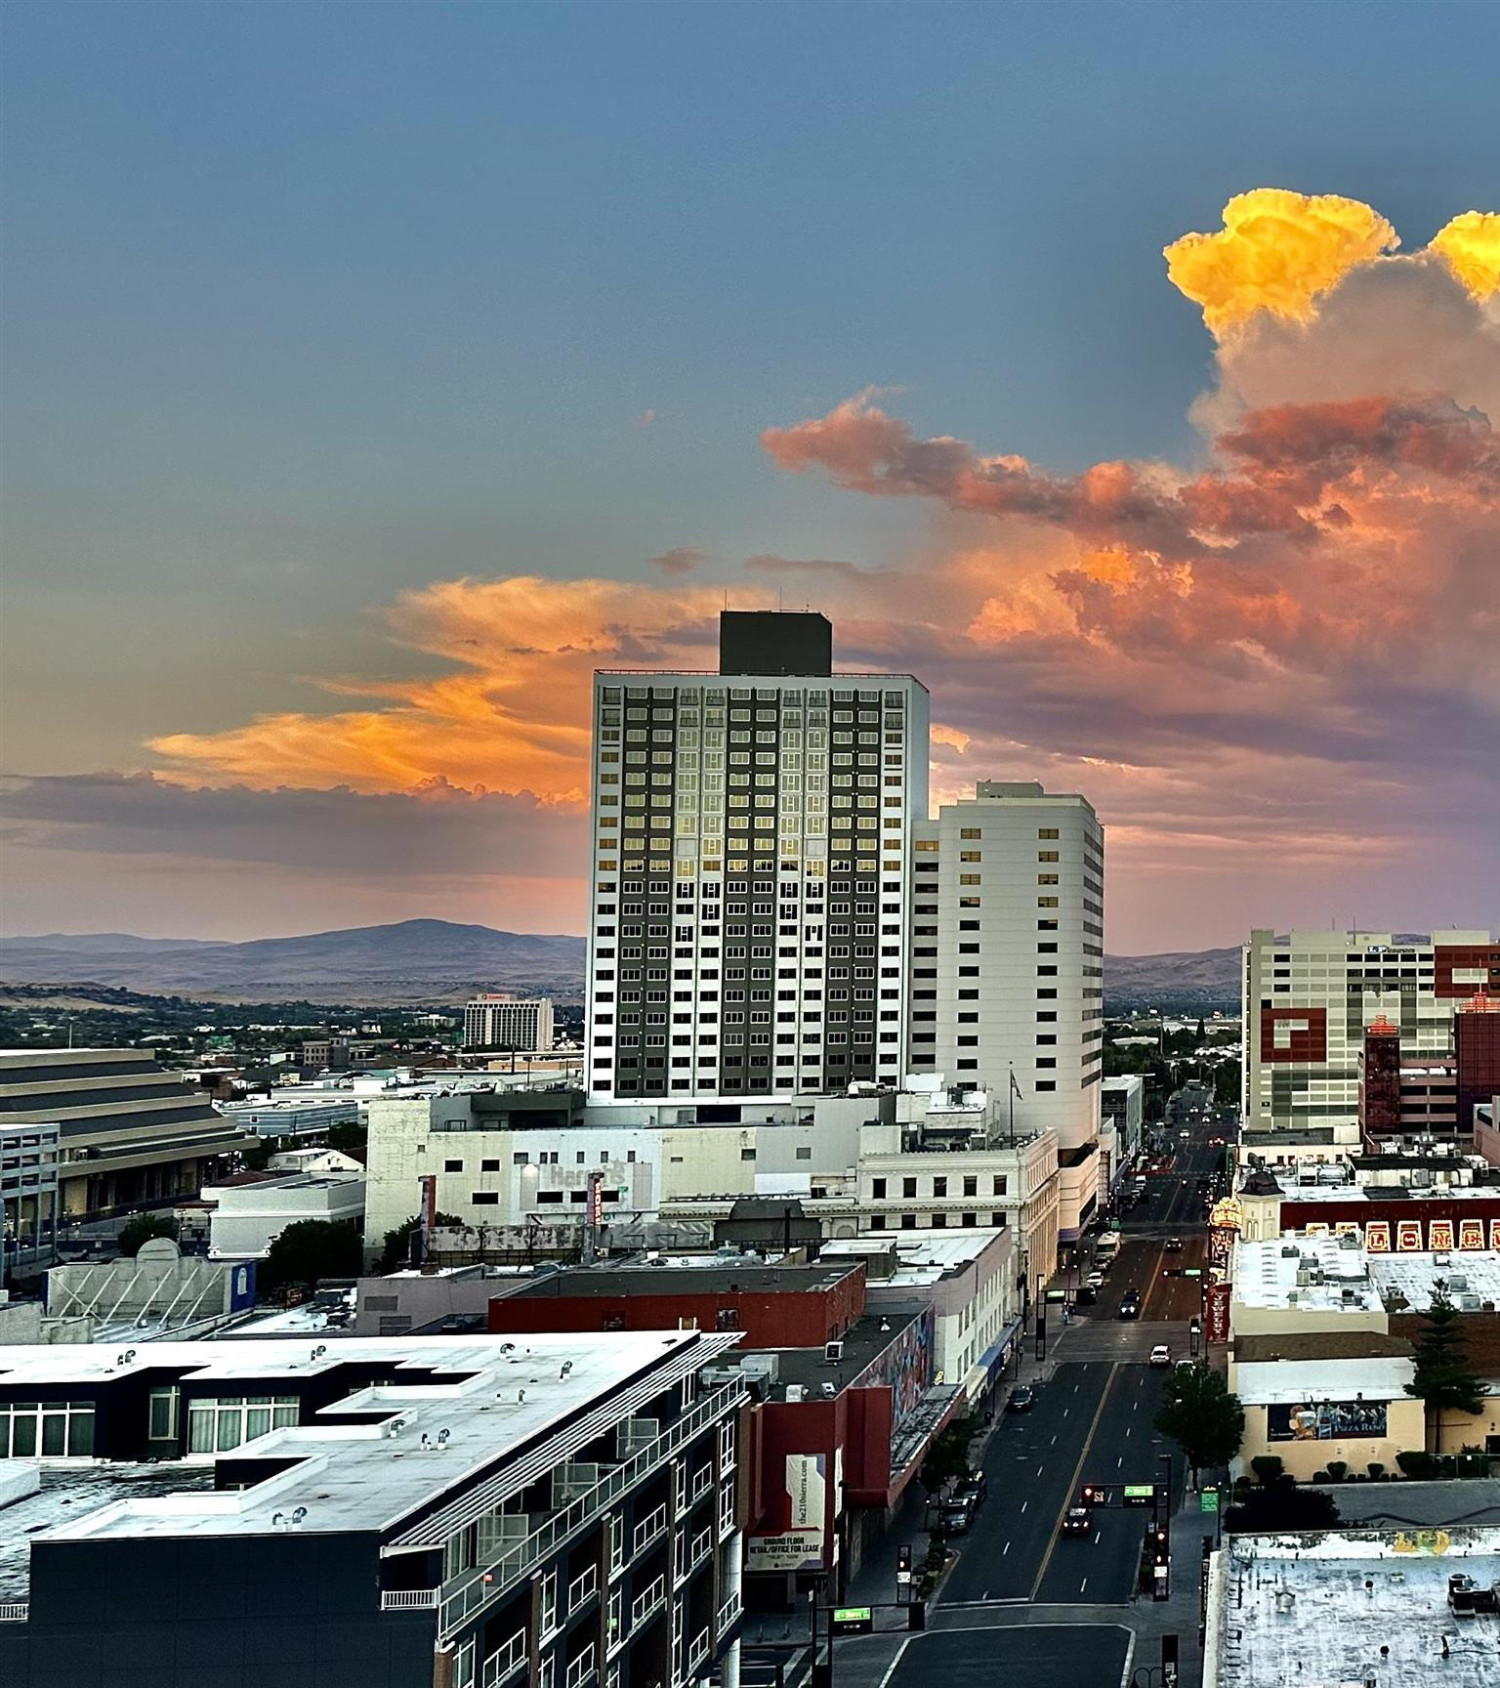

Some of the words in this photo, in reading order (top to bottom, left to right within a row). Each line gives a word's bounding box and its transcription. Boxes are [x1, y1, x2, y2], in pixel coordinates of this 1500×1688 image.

[1211, 1294, 1226, 1334] JEWELRY
[798, 1460, 808, 1524] the210sierra.com
[786, 1536, 805, 1545] FLOOR
[790, 1545, 801, 1553] FOR
[802, 1544, 819, 1553] LEASE
